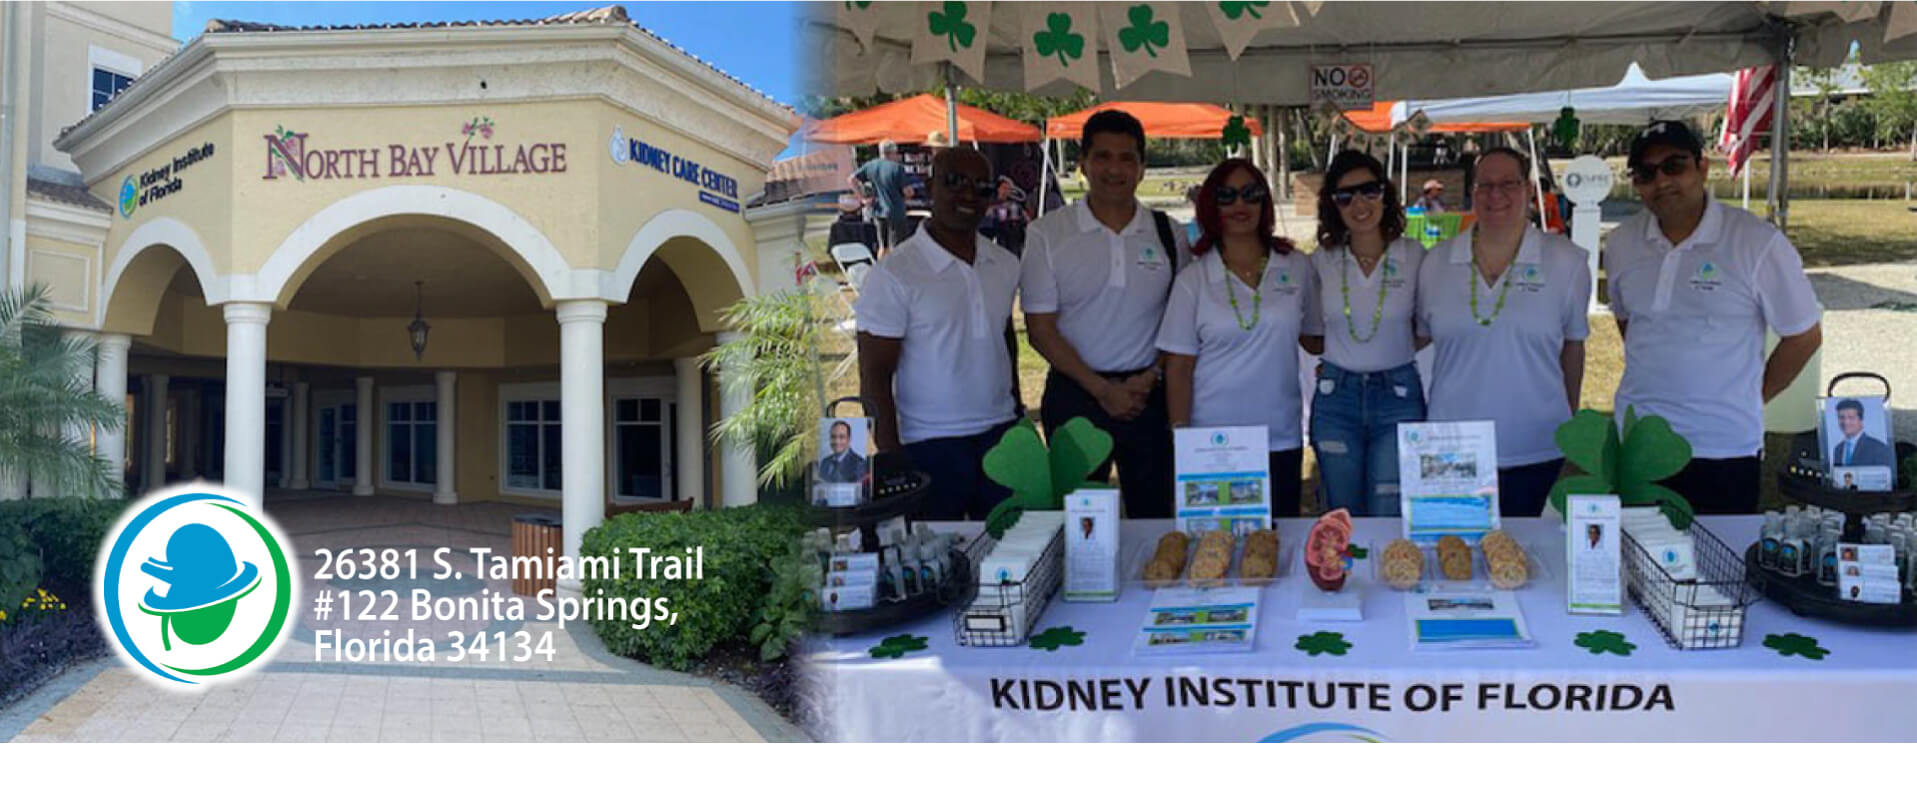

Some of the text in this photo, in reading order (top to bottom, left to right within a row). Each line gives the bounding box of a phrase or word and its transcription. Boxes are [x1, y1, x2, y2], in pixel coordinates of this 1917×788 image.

[1313, 88, 1372, 101] SMOKING
[1314, 67, 1346, 87] NO
[140, 142, 214, 189] Kidney Institute
[263, 132, 567, 181] NORTH BAY VILLAGE
[629, 137, 738, 199] KIDNEY CARE CENTER
[139, 176, 182, 207] of Florida
[990, 676, 1675, 712] KIDNEY INSTITUTE OF FLORIDA
